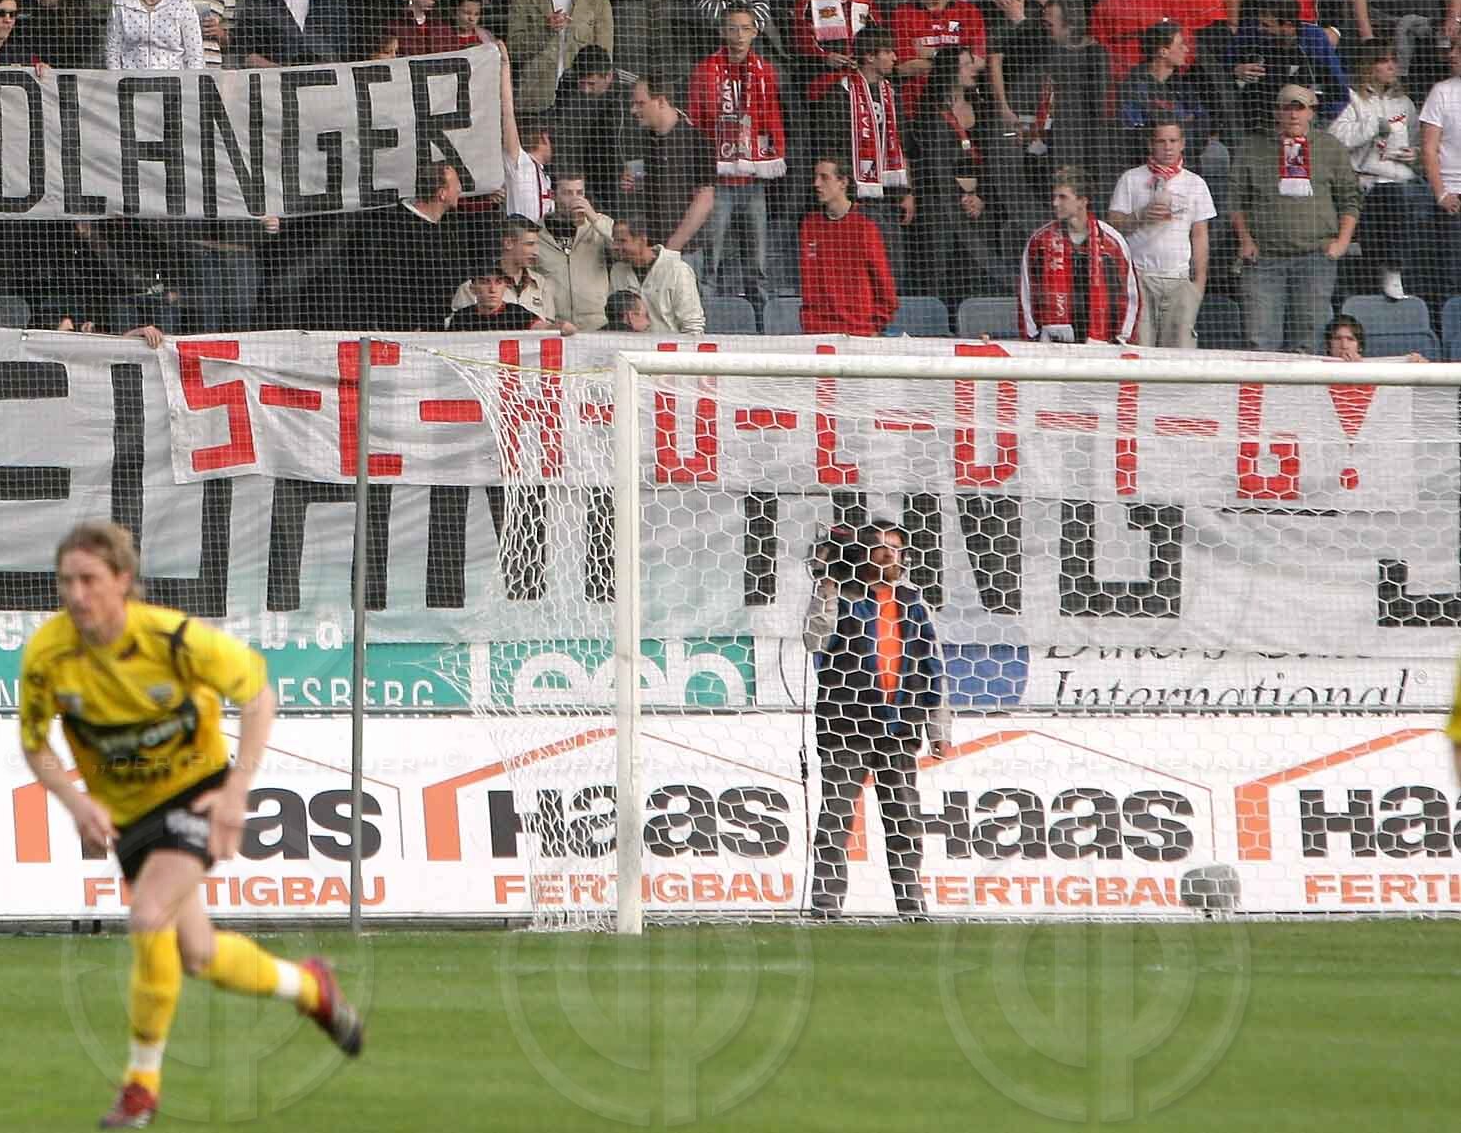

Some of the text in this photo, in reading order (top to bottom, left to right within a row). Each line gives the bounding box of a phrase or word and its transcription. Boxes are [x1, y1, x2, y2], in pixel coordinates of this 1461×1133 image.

[1047, 667, 1409, 716] International
[1299, 785, 1461, 859] Ha
[84, 875, 387, 908] FTIGBAU
[494, 872, 795, 906] FERIGBAU
